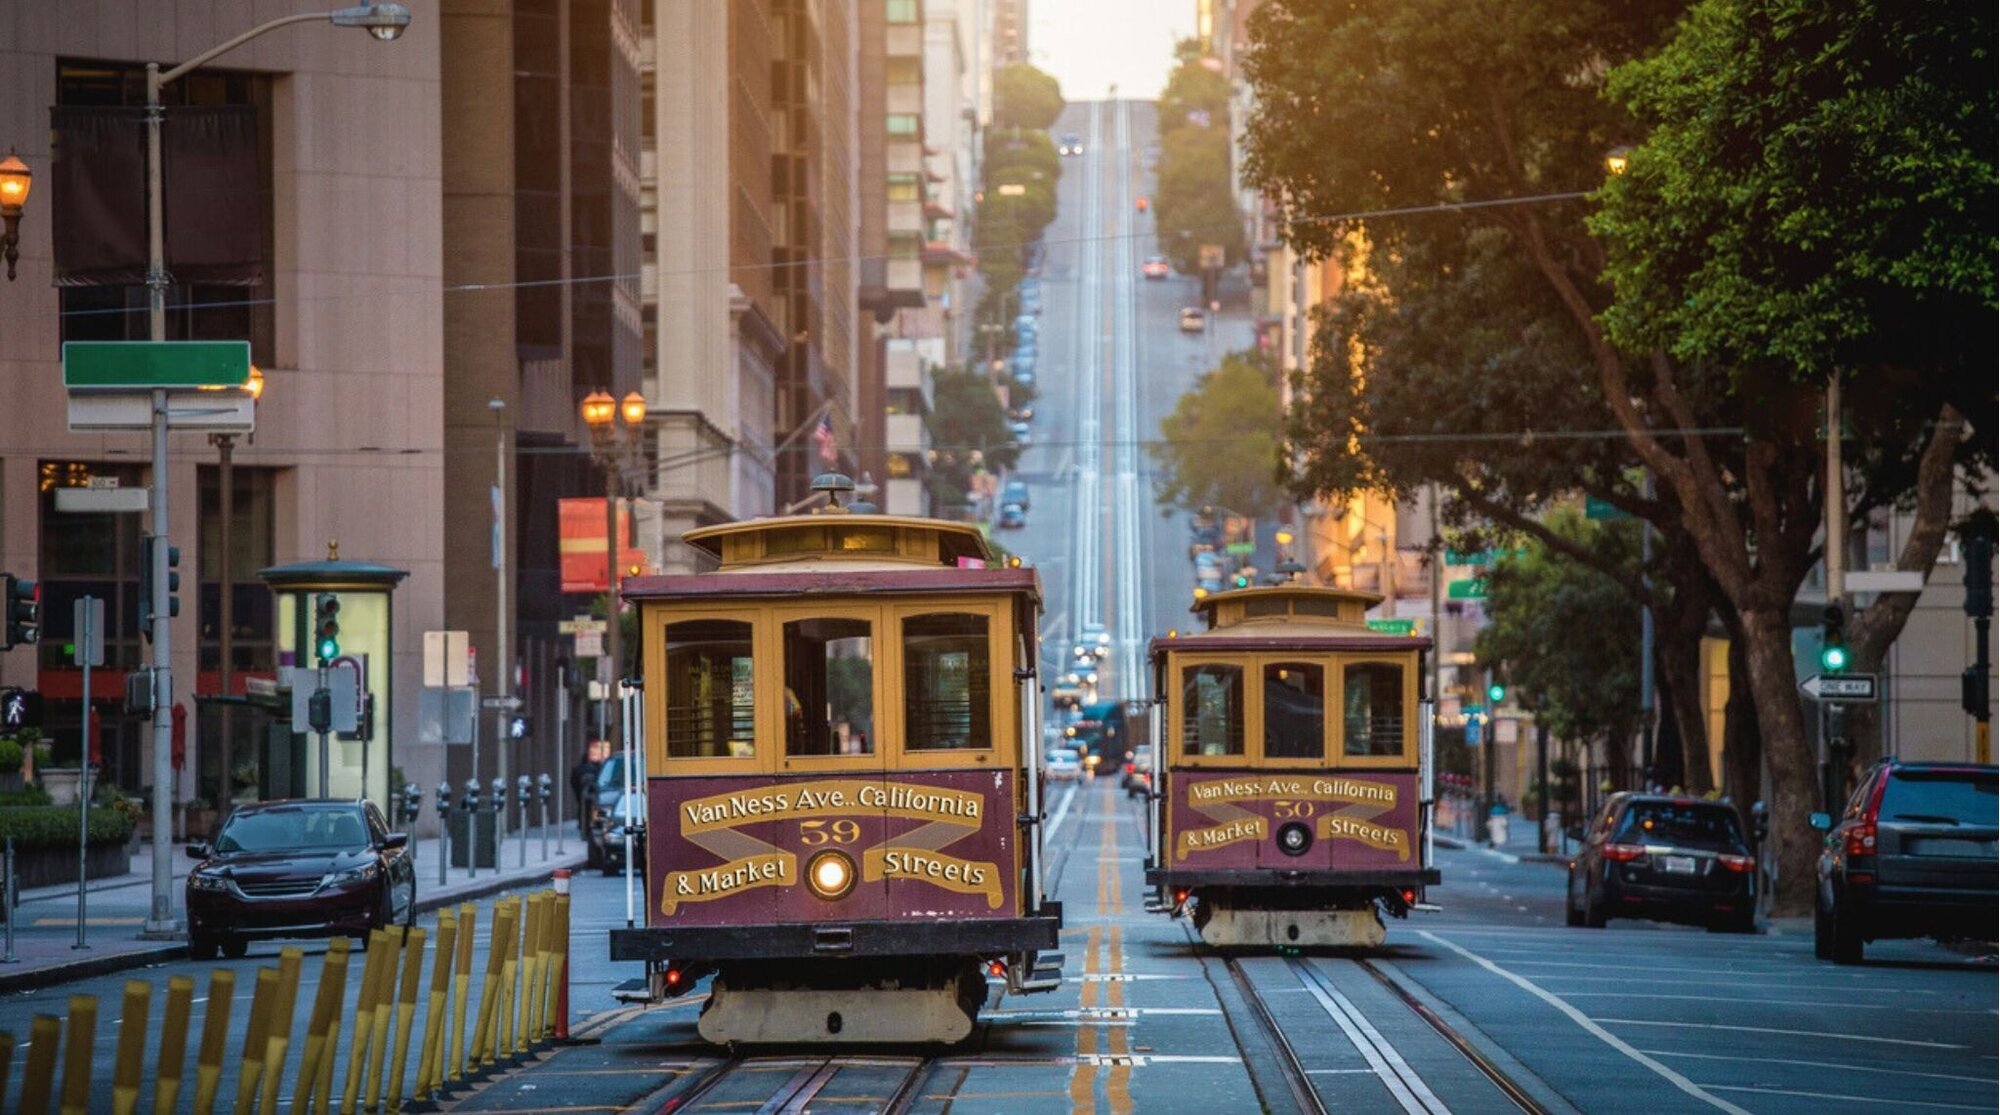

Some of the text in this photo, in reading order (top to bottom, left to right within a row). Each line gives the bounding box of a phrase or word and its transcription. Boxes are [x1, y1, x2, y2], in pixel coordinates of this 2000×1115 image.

[1820, 680, 1867, 694] ONE WAY
[1193, 785, 1221, 800] Van
[1223, 781, 1263, 797] Ness
[1313, 780, 1395, 801] California
[685, 804, 728, 825] Van
[730, 790, 789, 815] Ness
[859, 785, 979, 818] California
[1274, 800, 1314, 818] 50
[799, 819, 861, 845] 59
[1186, 818, 1399, 846] & Market Streets
[676, 850, 986, 896] & Market Streets
